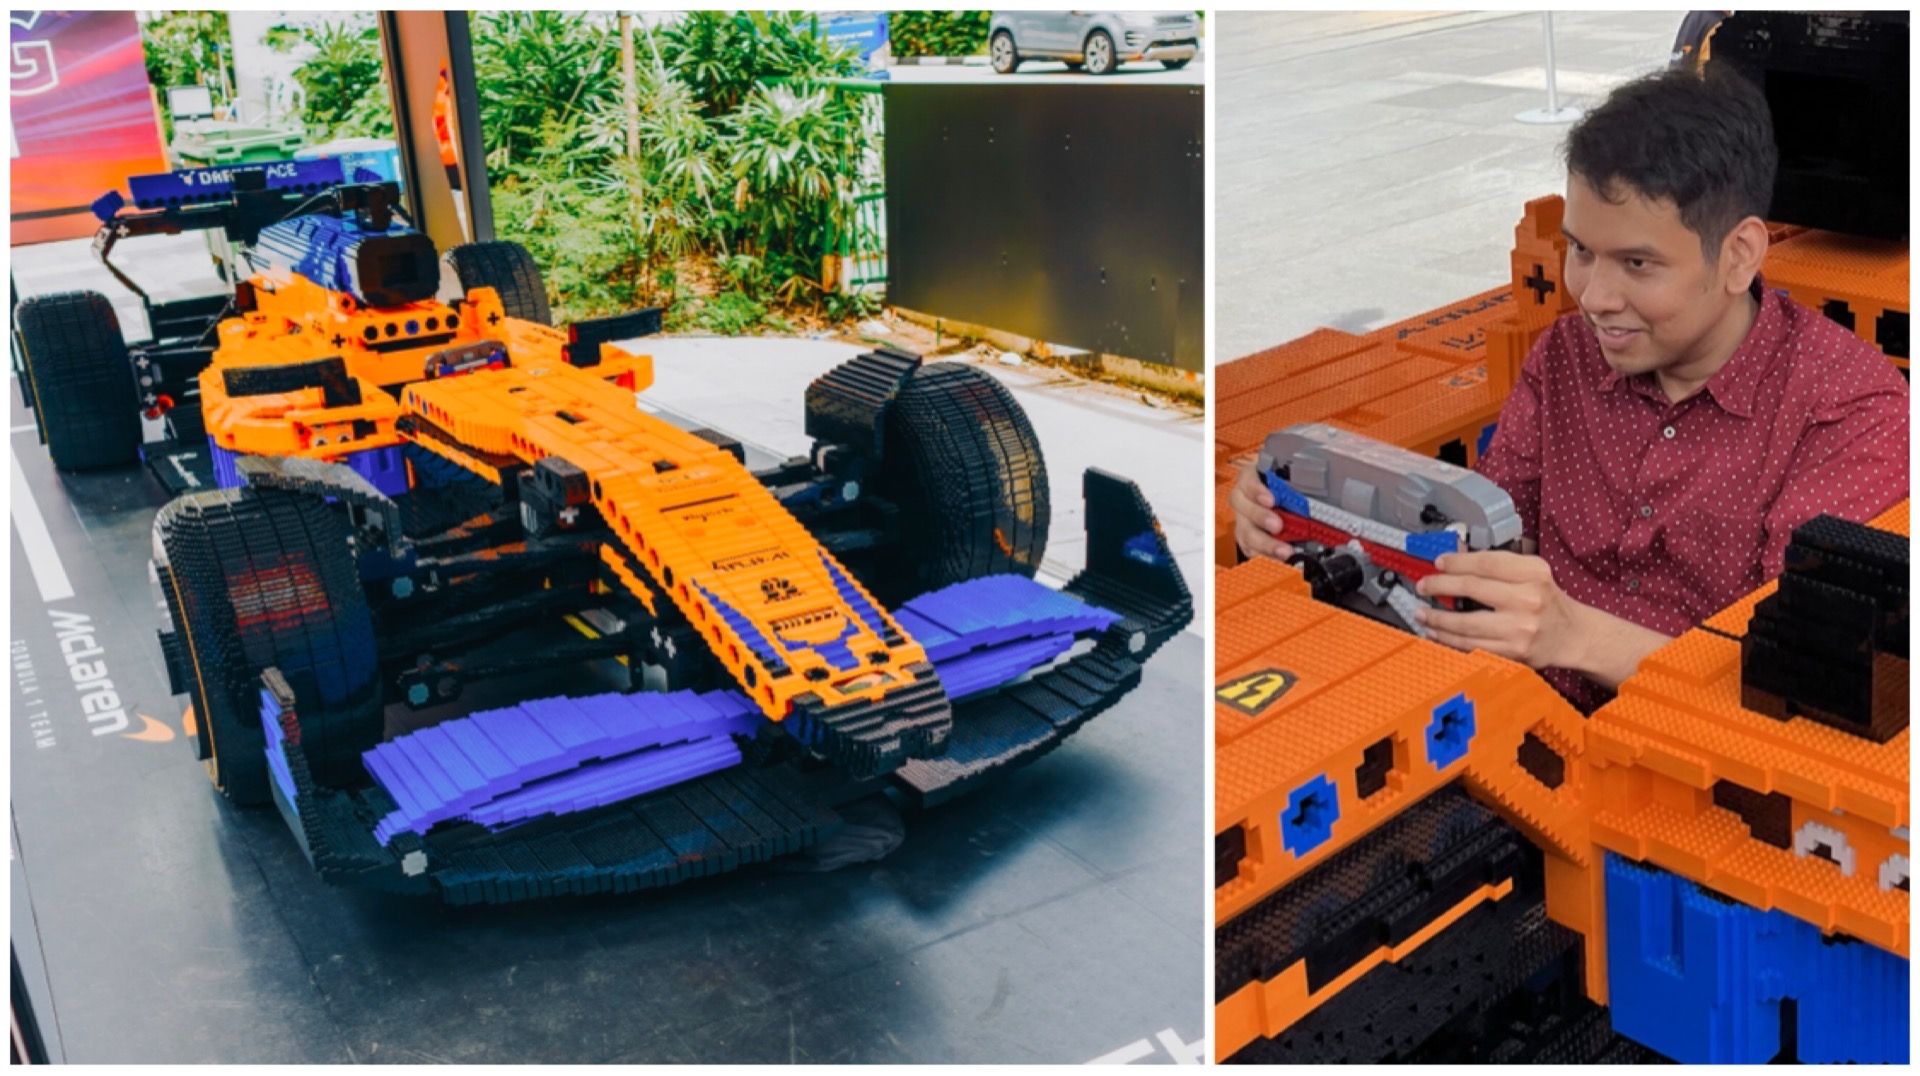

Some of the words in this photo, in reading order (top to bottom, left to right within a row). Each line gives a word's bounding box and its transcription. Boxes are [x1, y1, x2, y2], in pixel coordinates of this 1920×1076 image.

[199, 163, 298, 186] DARACE
[10, 639, 39, 695] FORMULA
[29, 711, 57, 749] TEAM
[47, 609, 129, 737] McLaren
